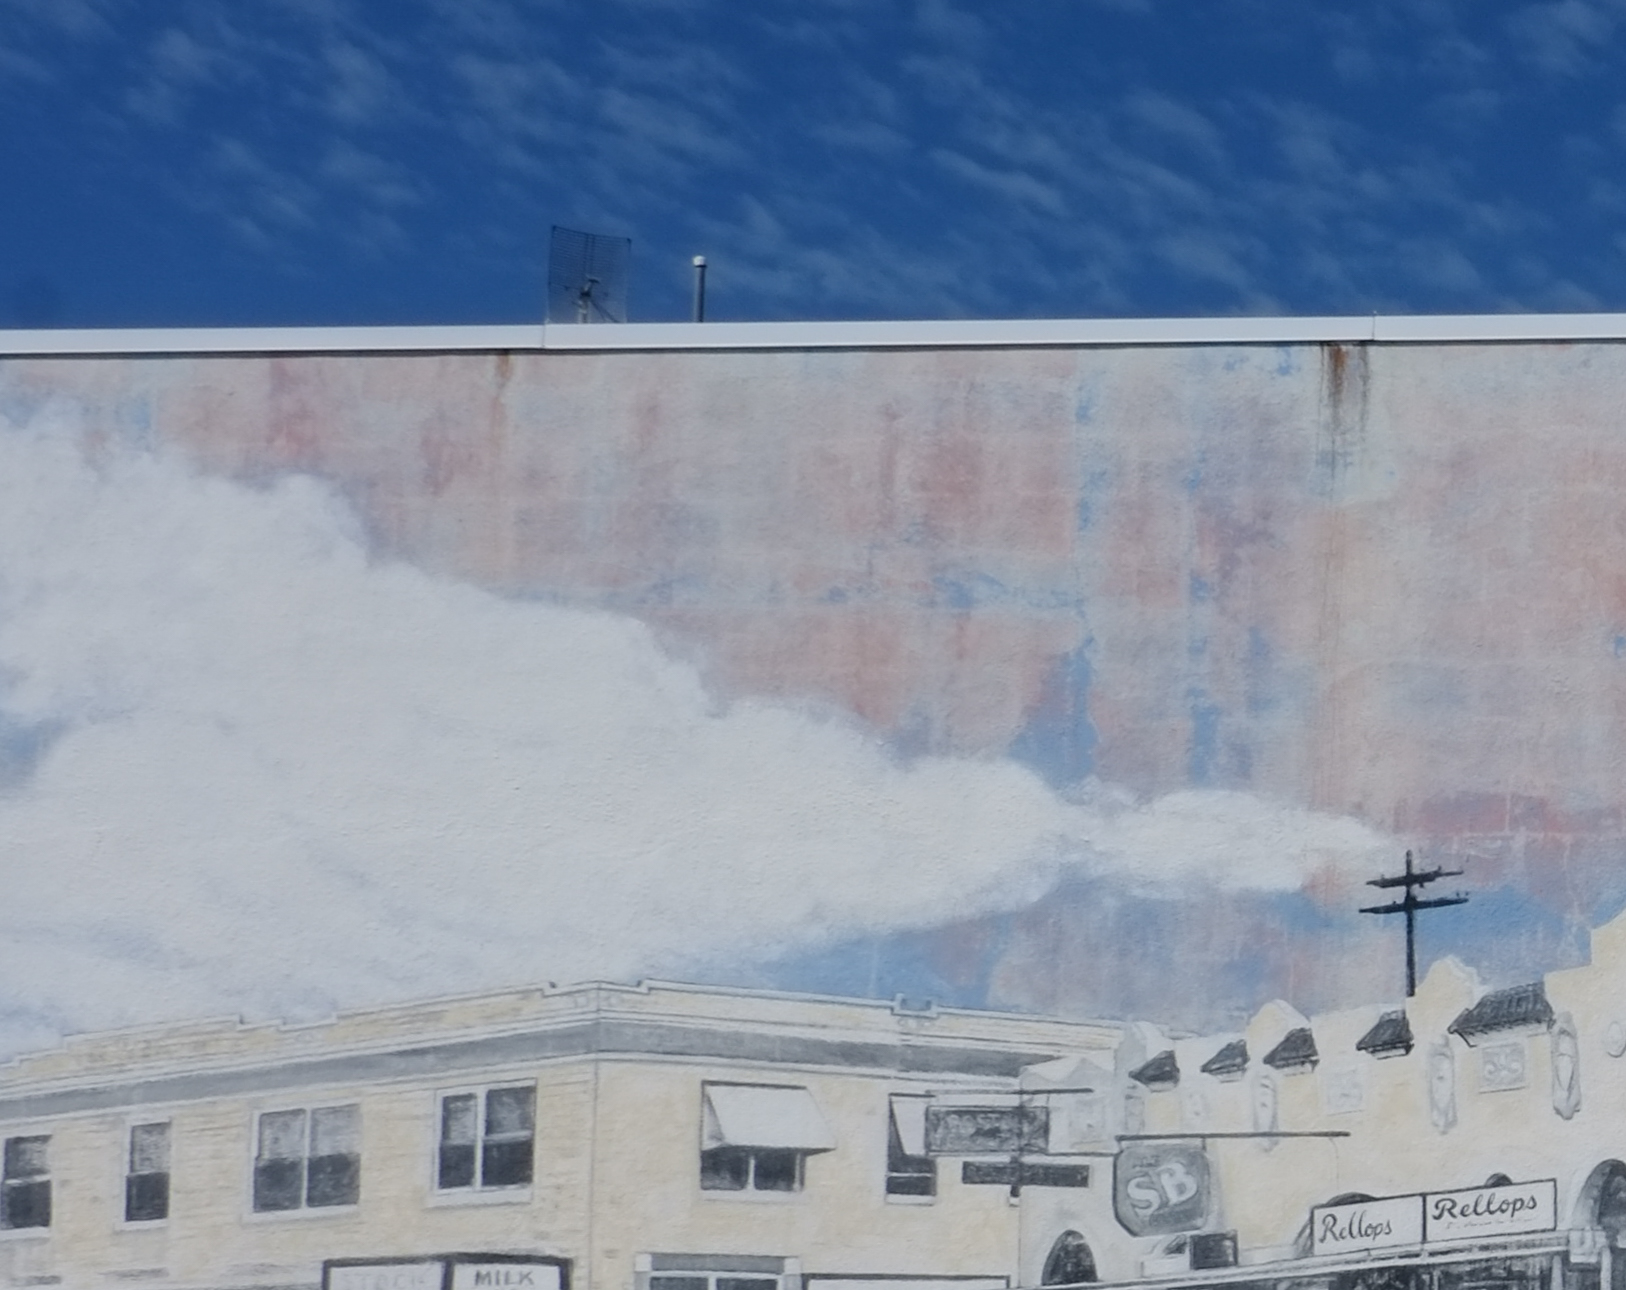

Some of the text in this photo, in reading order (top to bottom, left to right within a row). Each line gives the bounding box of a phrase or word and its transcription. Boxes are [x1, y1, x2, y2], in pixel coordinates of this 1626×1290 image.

[1432, 1192, 1539, 1221] Rellops
[1318, 1209, 1394, 1245] Rellops
[474, 1270, 535, 1286] MILK
